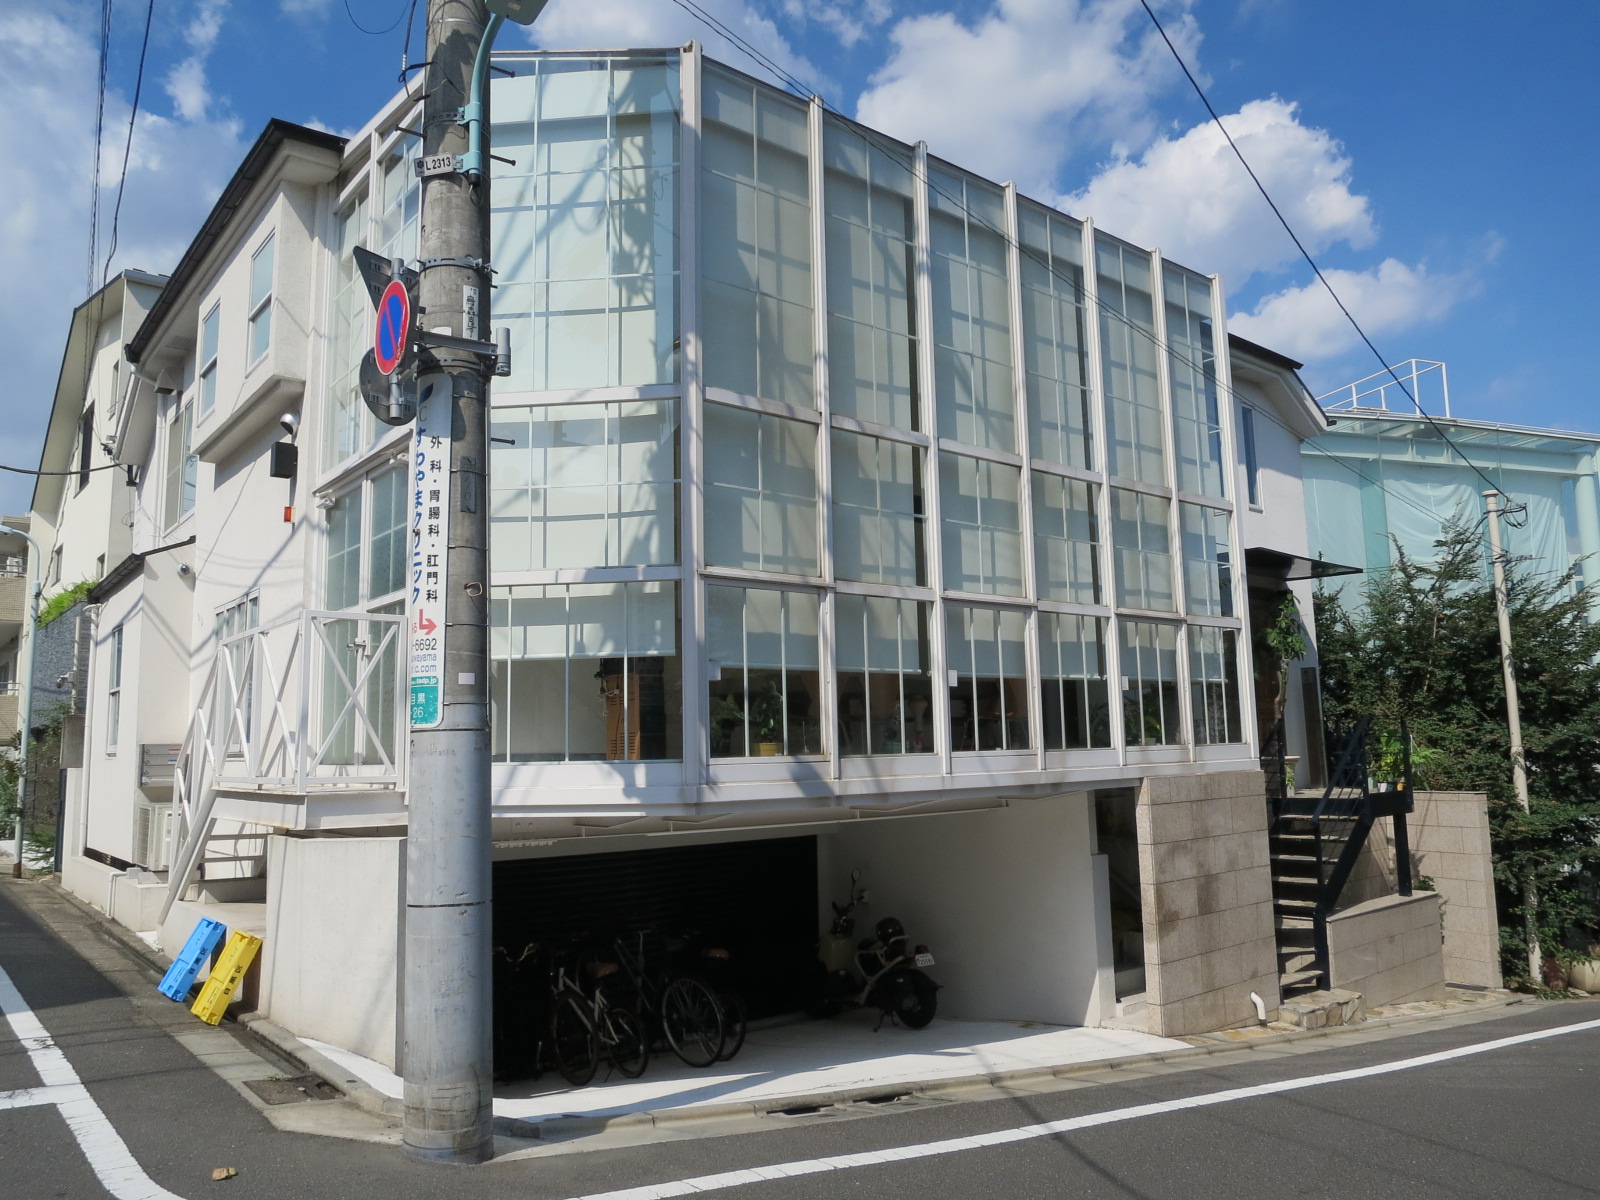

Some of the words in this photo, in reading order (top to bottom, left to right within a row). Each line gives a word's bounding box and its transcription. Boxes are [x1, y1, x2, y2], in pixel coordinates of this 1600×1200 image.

[426, 436, 443, 603] 外科・胃腸科・肛門科
